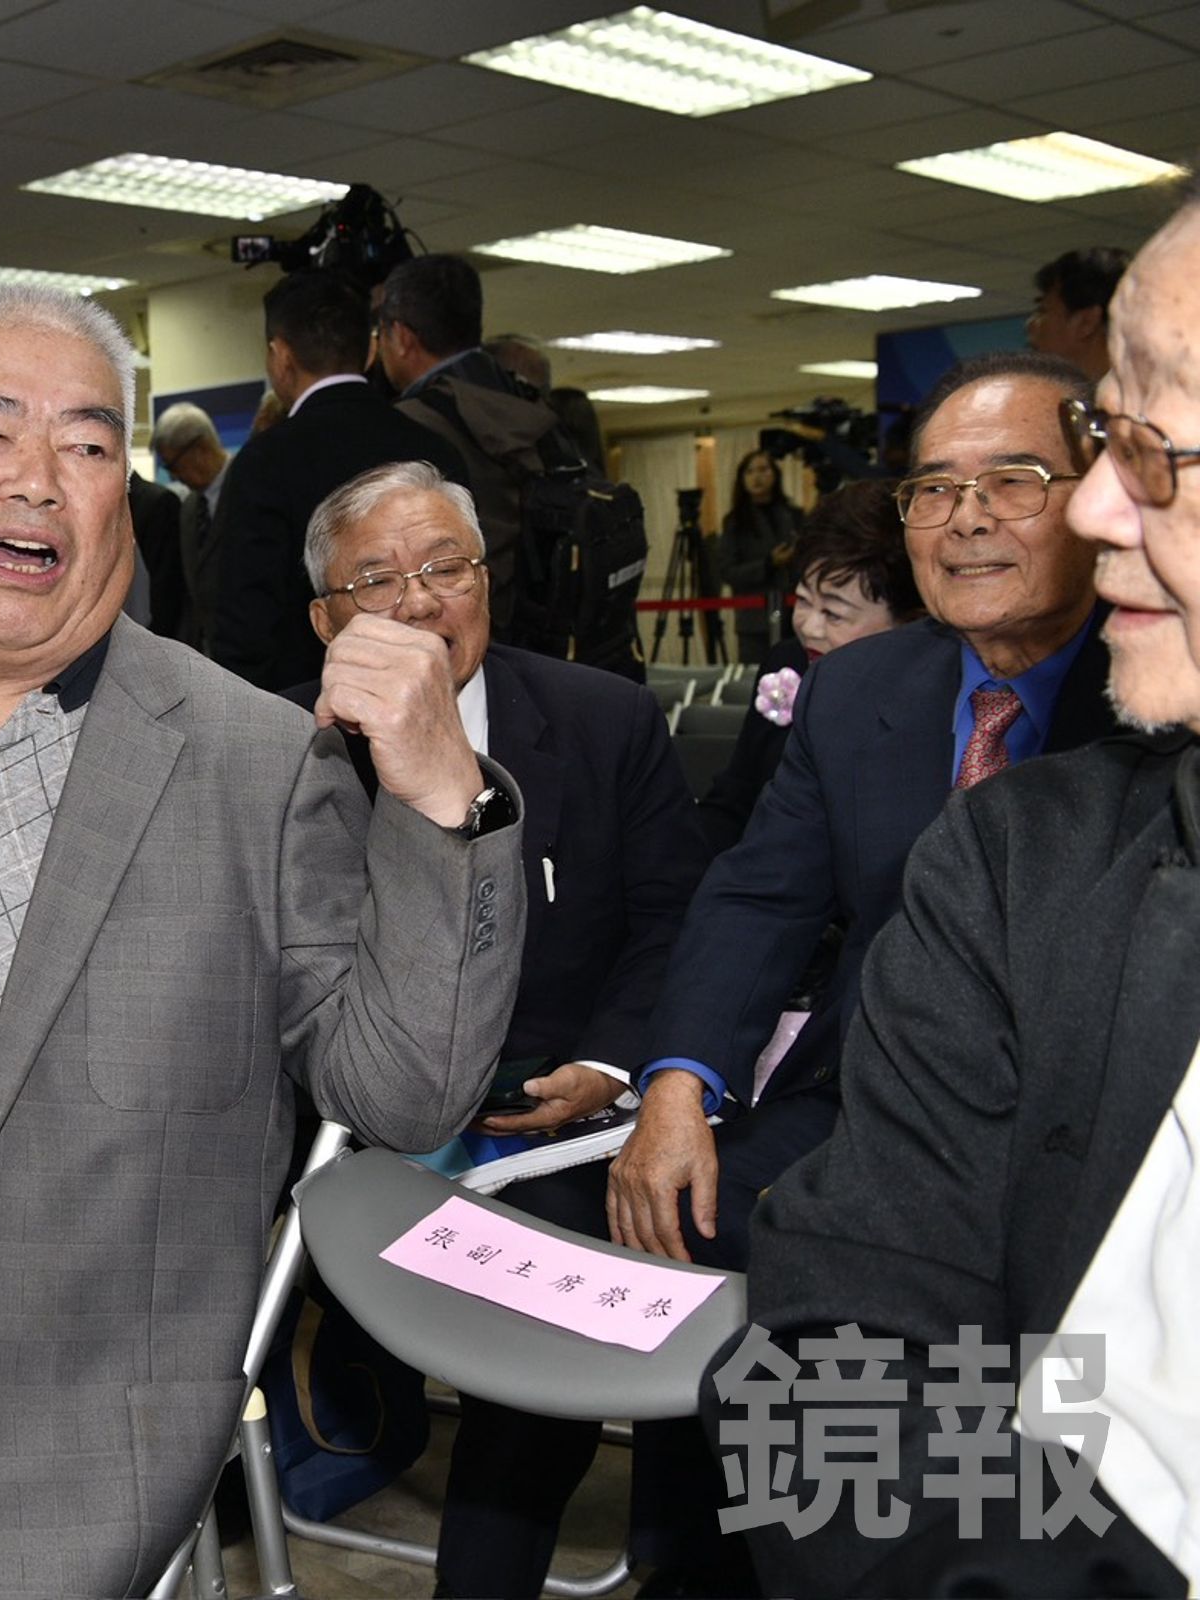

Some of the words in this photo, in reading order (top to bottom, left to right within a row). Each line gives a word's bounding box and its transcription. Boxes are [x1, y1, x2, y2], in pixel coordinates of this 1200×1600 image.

[424, 1226, 672, 1319] 張副主席榮恭
